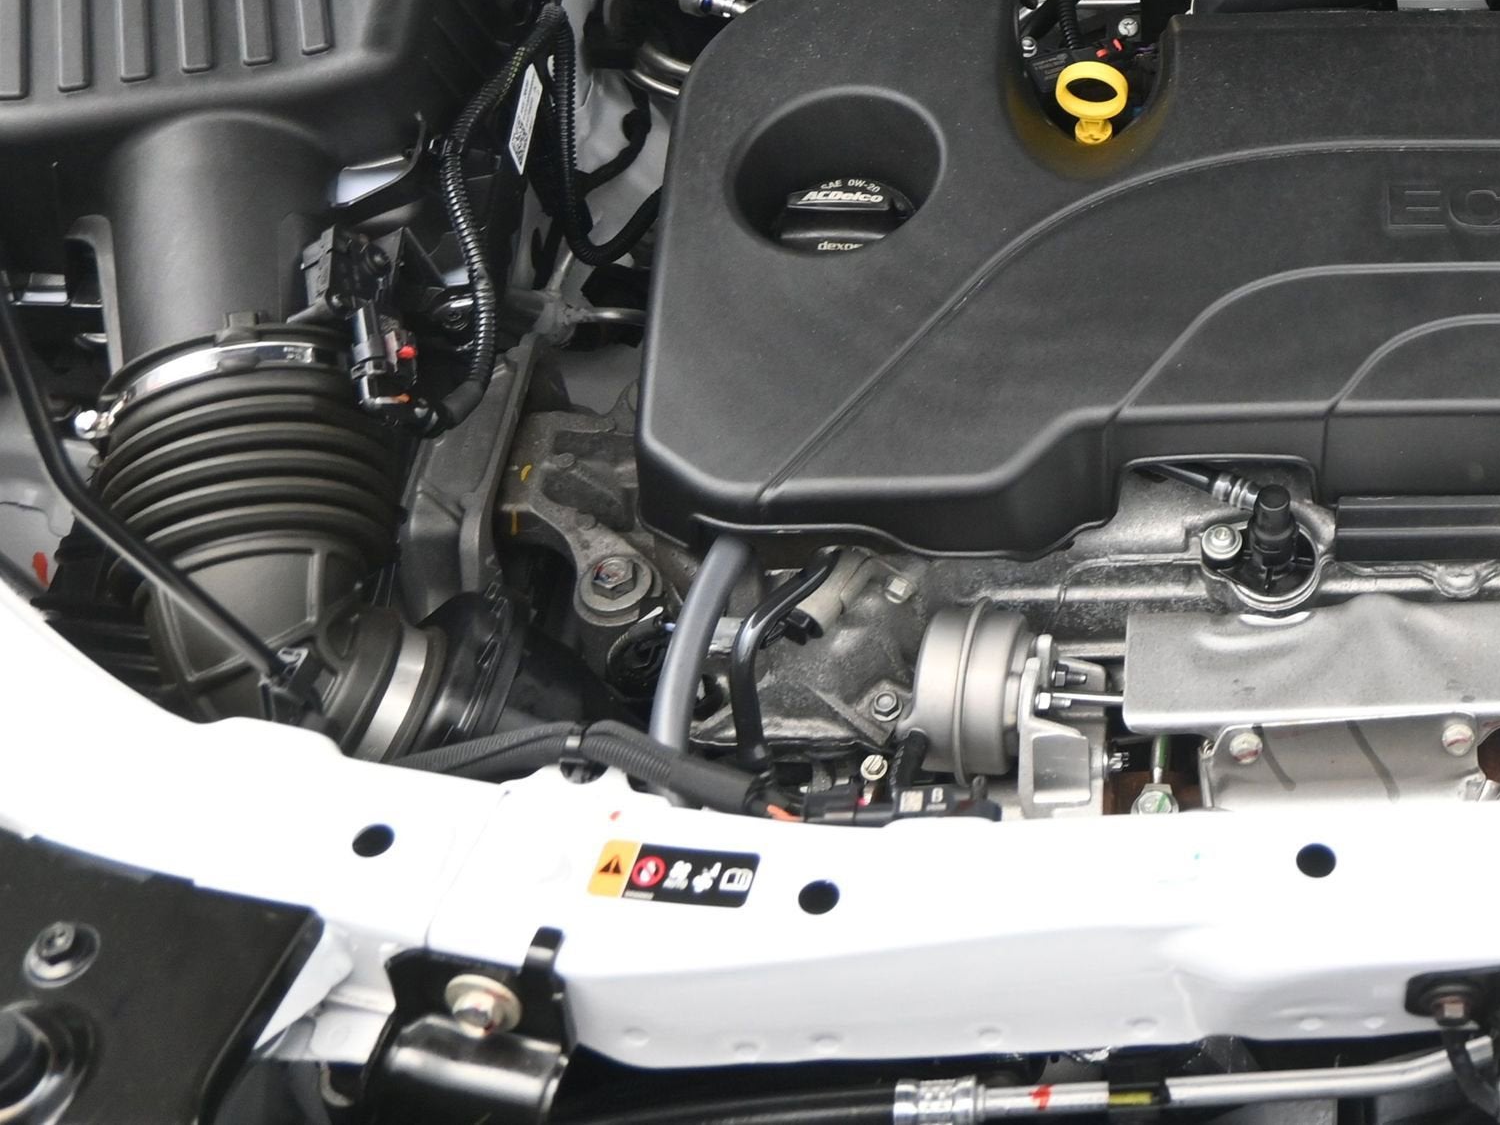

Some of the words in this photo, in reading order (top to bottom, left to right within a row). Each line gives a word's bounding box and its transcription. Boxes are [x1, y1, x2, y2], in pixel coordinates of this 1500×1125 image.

[820, 179, 842, 189] SAE
[847, 178, 881, 193] 0W-20
[800, 190, 884, 203] ACDelco
